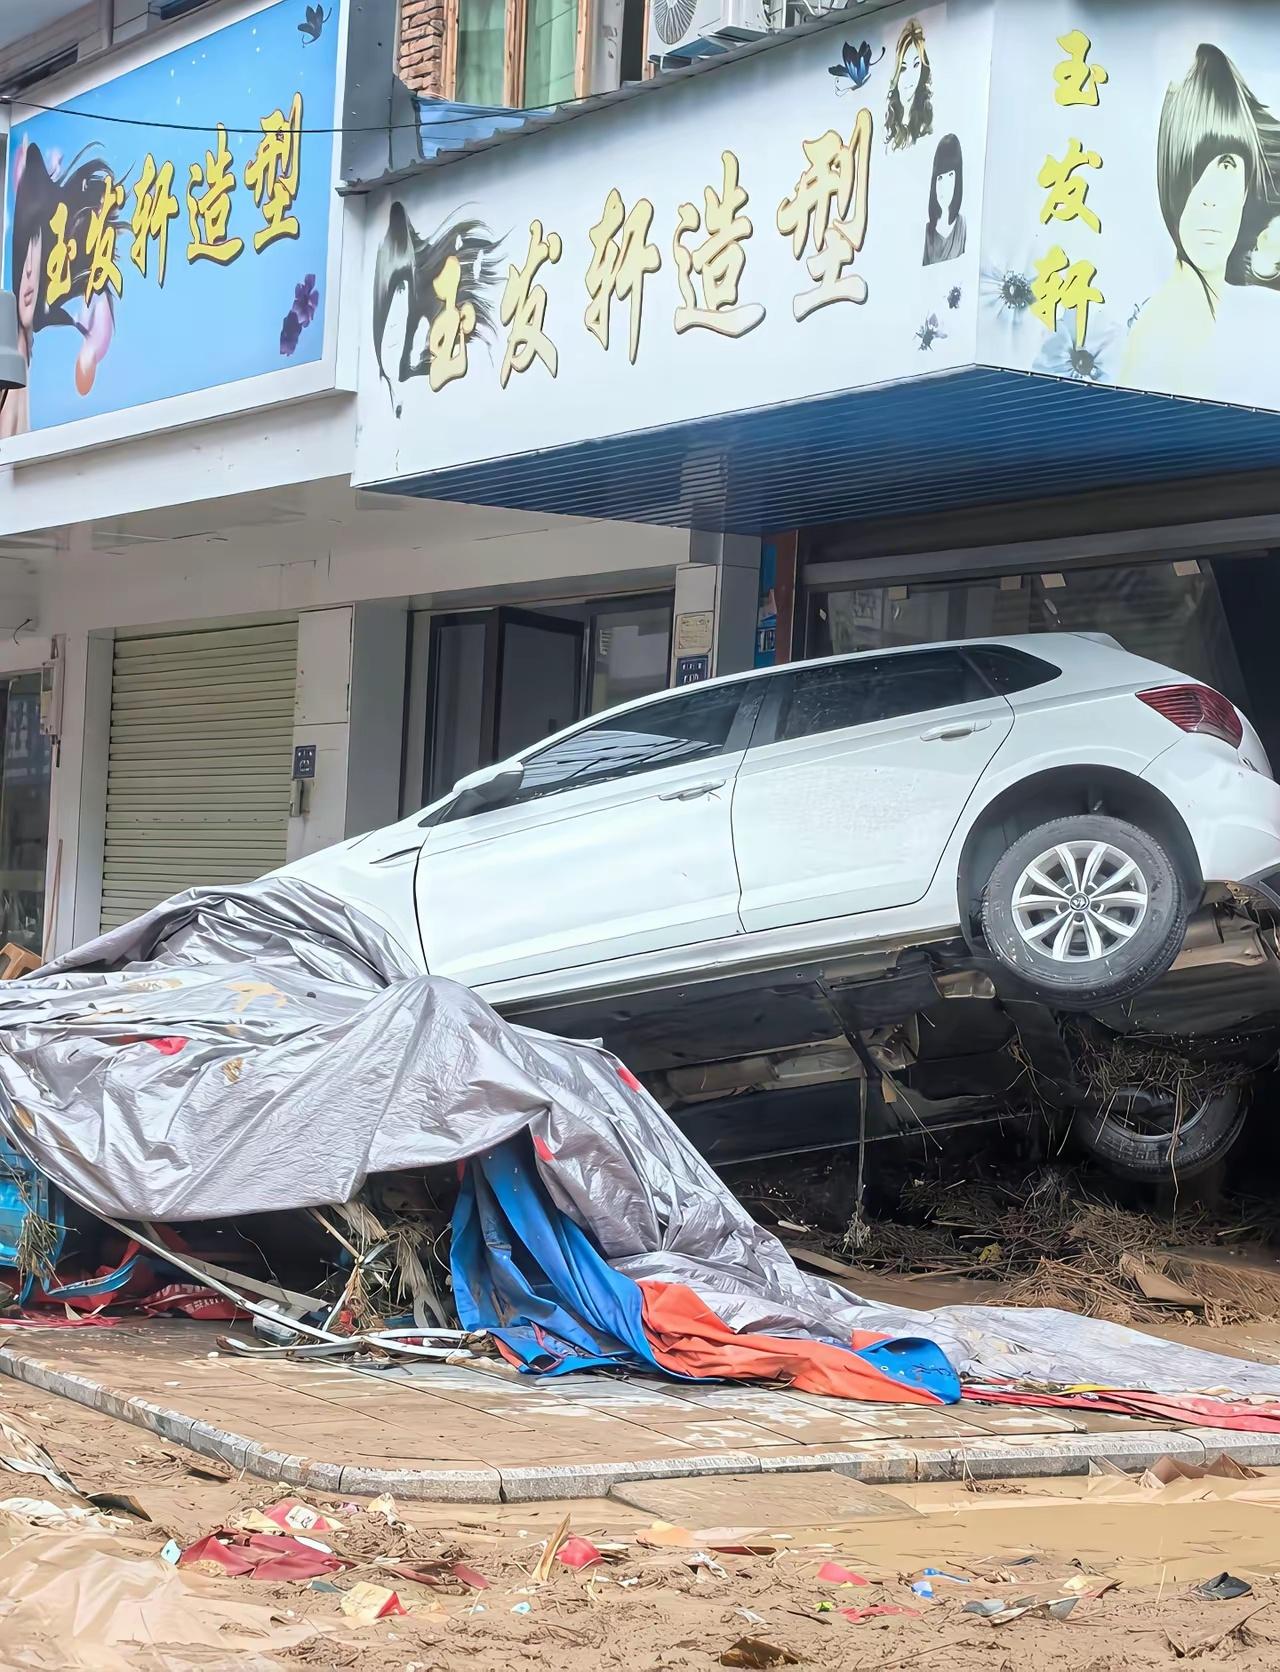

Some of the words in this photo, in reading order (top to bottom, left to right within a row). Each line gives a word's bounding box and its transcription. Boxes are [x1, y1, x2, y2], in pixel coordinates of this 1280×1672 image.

[46, 91, 303, 308] 玉发轩造型
[429, 107, 872, 392] 玉发轩造型
[1029, 28, 1108, 349] 玉发轩
